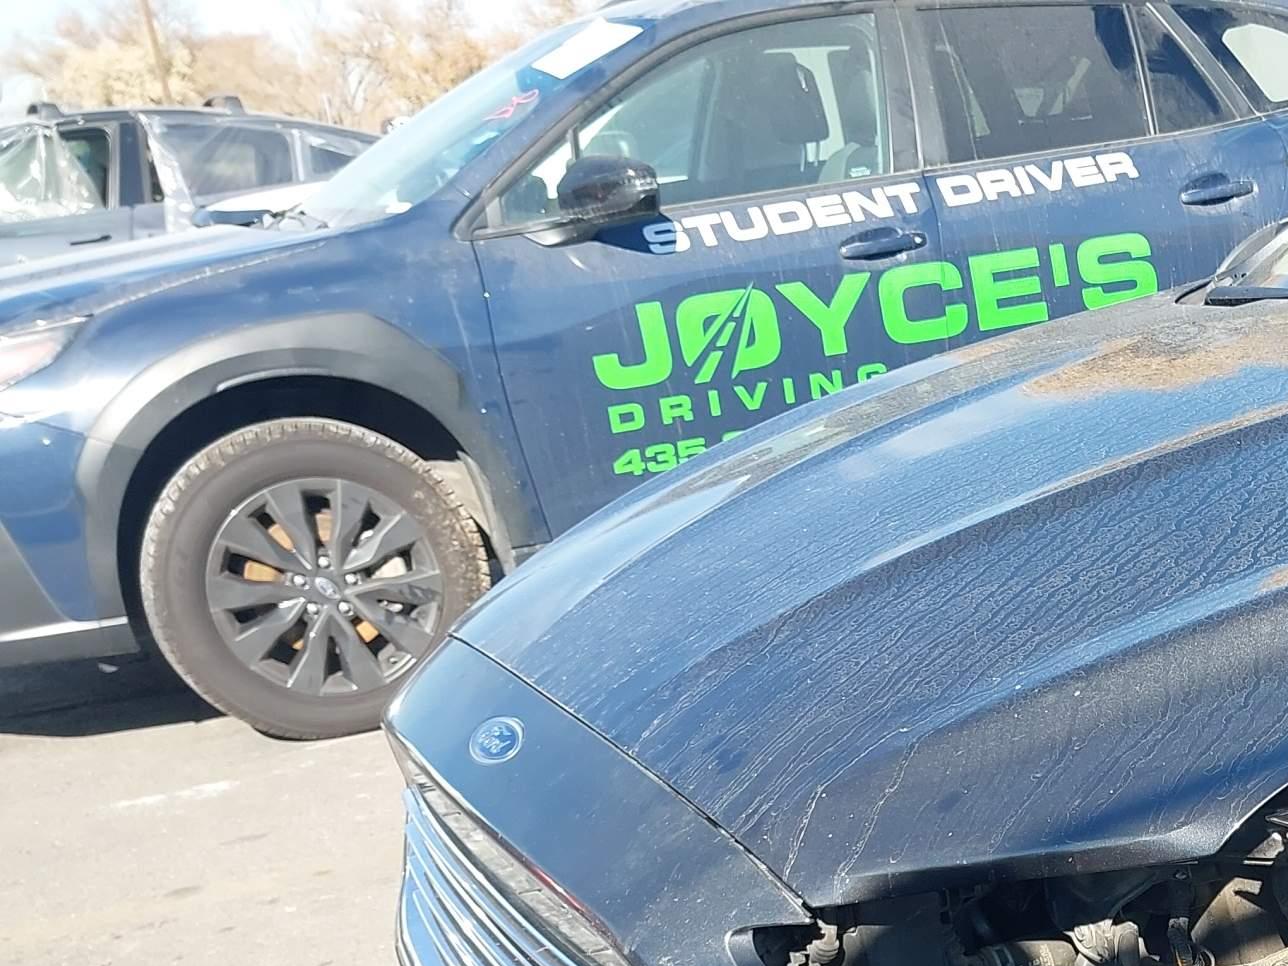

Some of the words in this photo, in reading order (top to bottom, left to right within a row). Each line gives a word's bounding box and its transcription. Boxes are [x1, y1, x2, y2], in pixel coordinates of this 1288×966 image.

[642, 181, 923, 256] STUDENT
[934, 150, 1141, 209] DRIVER
[592, 232, 1160, 391] JOYCE'S
